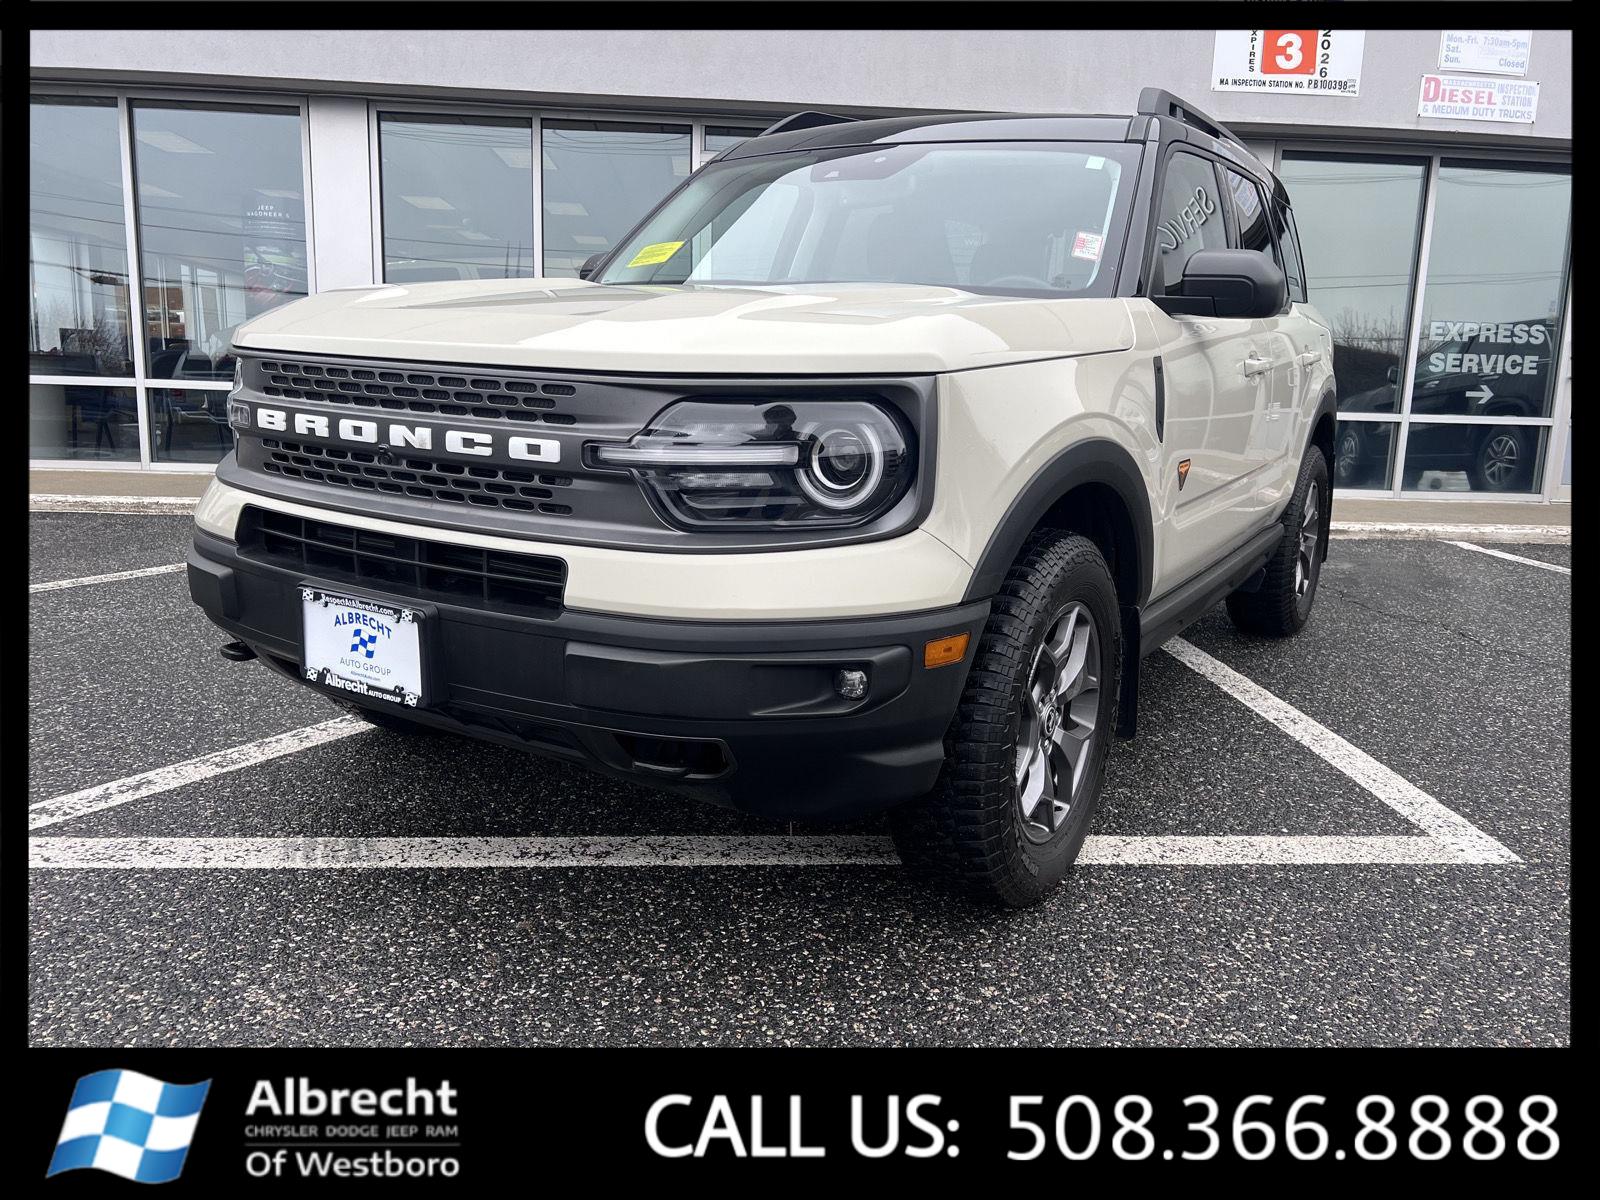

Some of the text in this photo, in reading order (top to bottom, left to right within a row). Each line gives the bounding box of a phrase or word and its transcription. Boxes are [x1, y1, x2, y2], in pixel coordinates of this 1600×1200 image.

[1248, 30, 1258, 73] XPIRES
[1275, 32, 1303, 70] 3
[1319, 30, 1332, 78] 2026
[1445, 44, 1461, 53] Sat.
[1444, 54, 1525, 68] Sun. Closed
[1219, 78, 1229, 86] MA
[1231, 78, 1267, 87] INSPECTION
[1268, 80, 1293, 88] STATION
[1295, 81, 1305, 89] NO.
[1422, 76, 1497, 106] DIESEL
[1497, 83, 1536, 96] INSPECTION
[1432, 105, 1469, 116] MEDIUM
[1472, 107, 1496, 117] DUTY
[1499, 109, 1532, 120] TRUCKS
[1501, 95, 1532, 107] STATION
[1428, 321, 1546, 345] EXPRESS
[1428, 352, 1539, 375] SERVICE
[256, 407, 561, 463] BRONCO
[334, 611, 392, 640] ALBRECHT
[339, 657, 392, 676] AUTO GROUP
[325, 672, 402, 703] Albrecht AUTO GROUP
